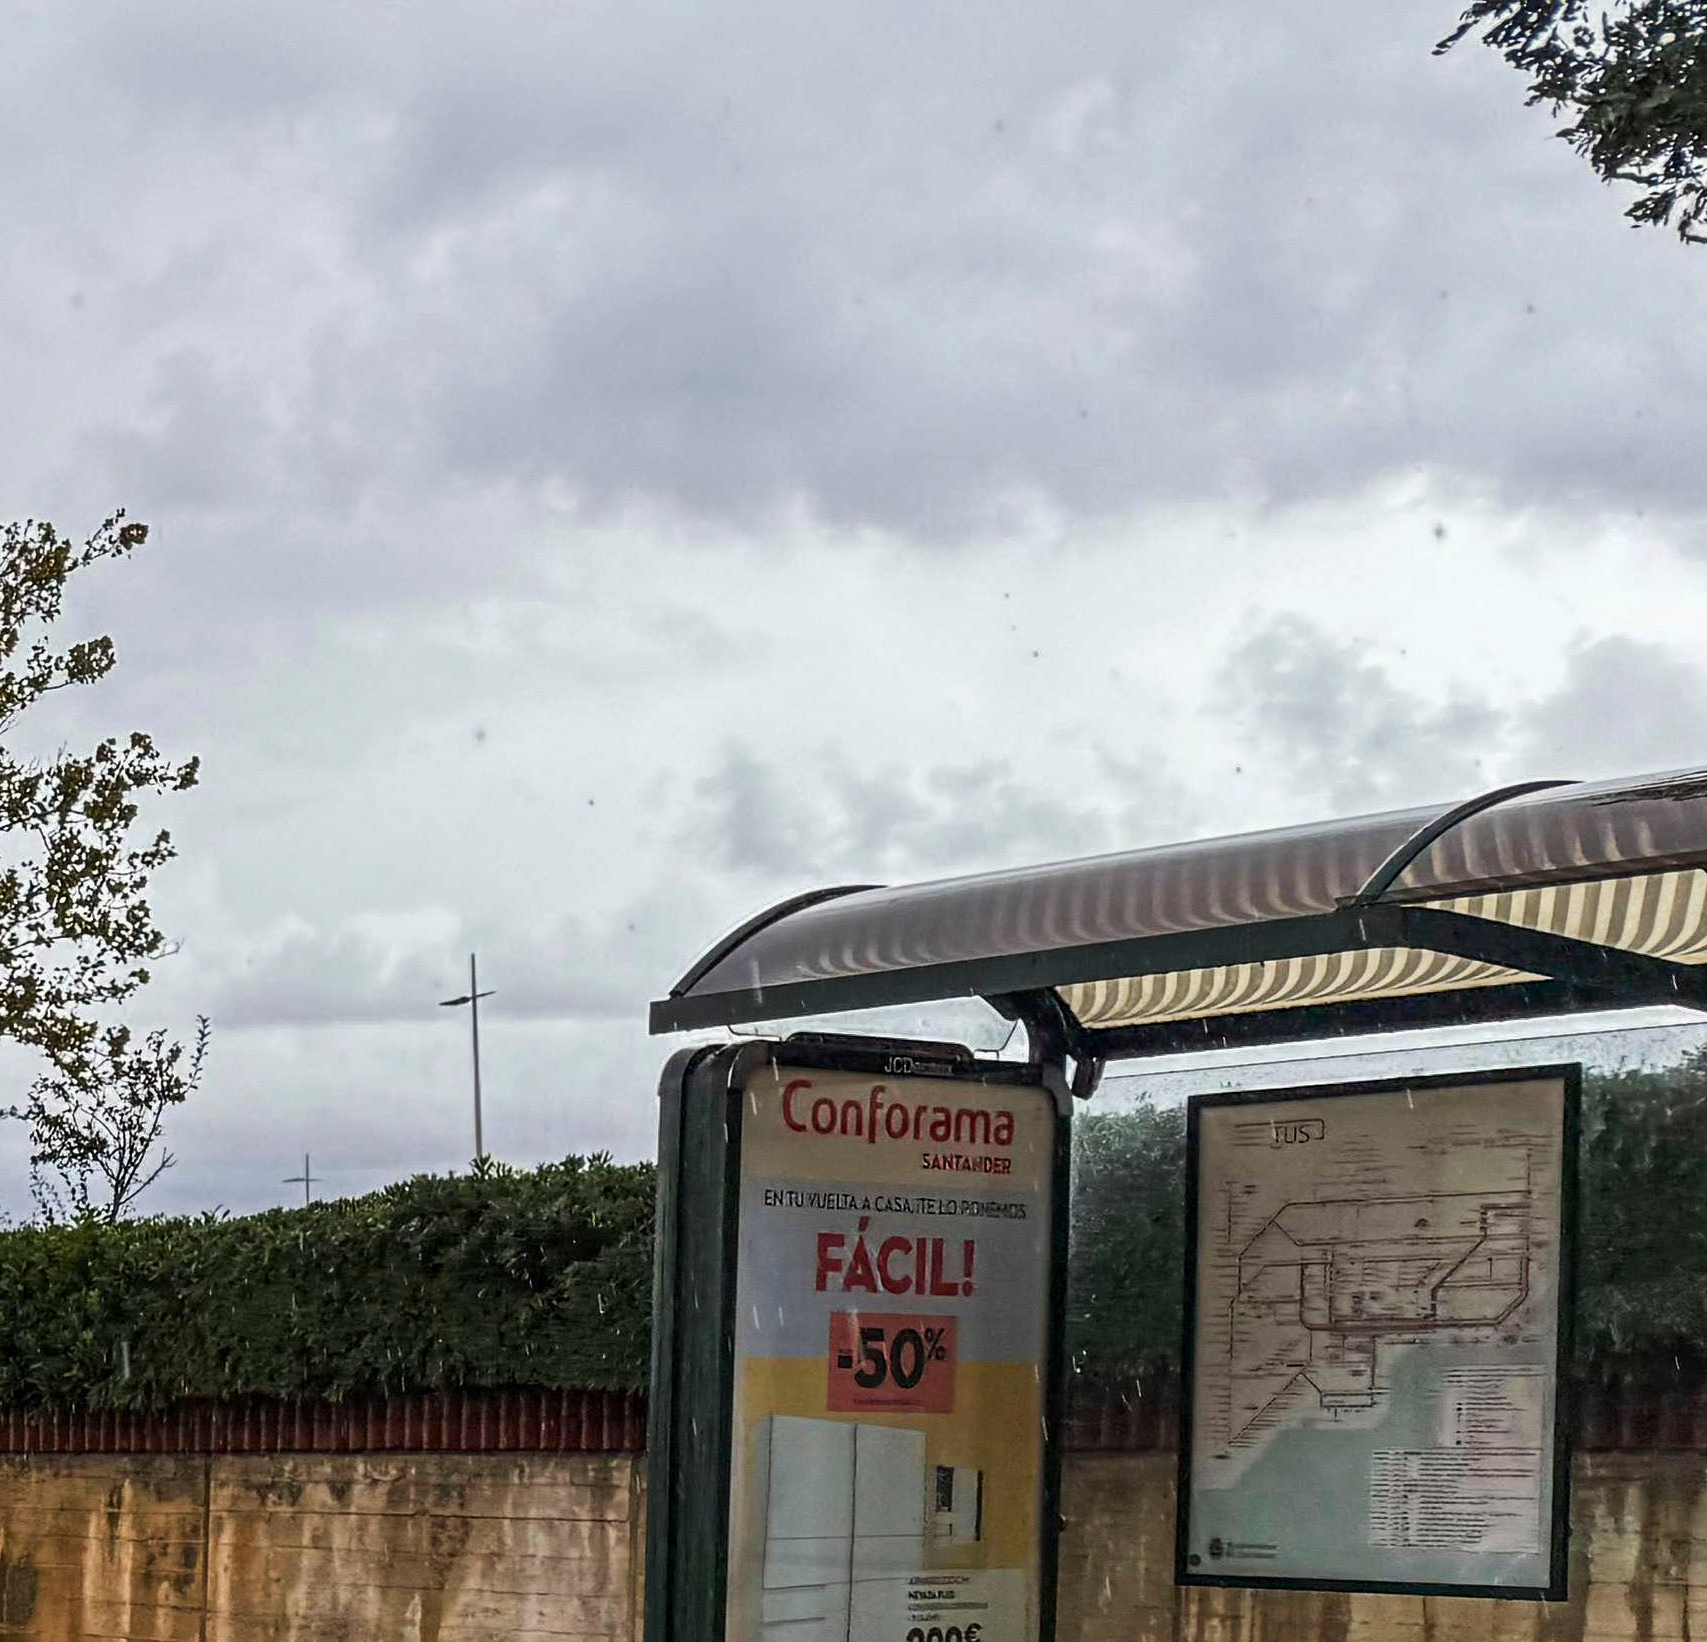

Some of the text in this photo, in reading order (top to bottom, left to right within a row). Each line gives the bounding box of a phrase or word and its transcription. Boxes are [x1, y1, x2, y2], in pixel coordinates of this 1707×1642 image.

[783, 1080, 1015, 1146] Conforama
[1272, 1126, 1311, 1143] TUS
[923, 1153, 1011, 1175] SANTANDER
[764, 1189, 784, 1207] EN
[786, 1190, 805, 1208] TU
[807, 1192, 858, 1211] VUELTA
[861, 1196, 872, 1211] A
[938, 1199, 958, 1216] LO
[816, 1216, 975, 1297] FÁCIL!
[837, 1327, 947, 1388] -50%
